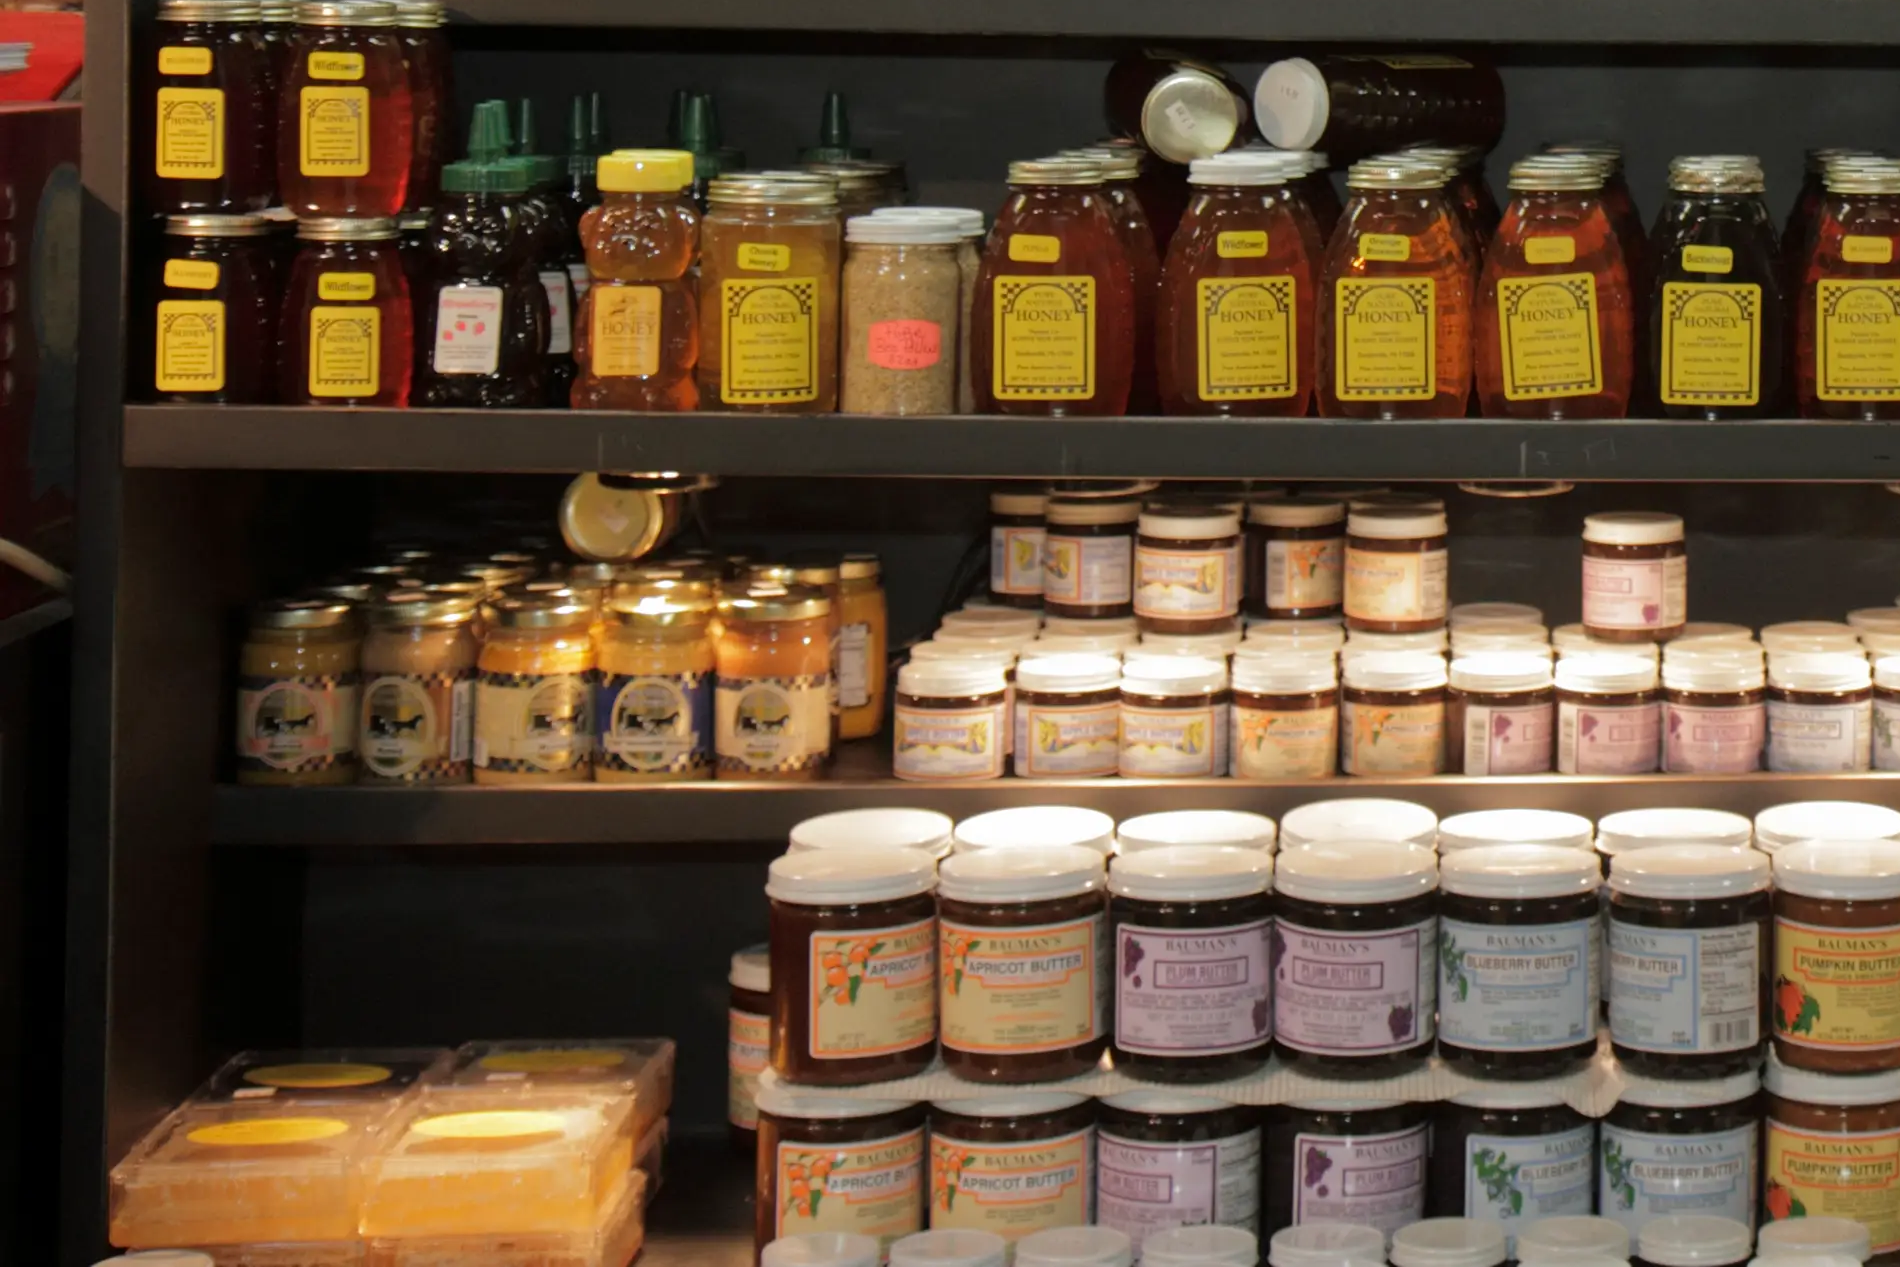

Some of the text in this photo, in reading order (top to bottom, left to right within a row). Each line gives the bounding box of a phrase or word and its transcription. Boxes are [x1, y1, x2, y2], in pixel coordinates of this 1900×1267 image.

[1222, 239, 1264, 250] Wildflower
[742, 313, 798, 325] HONEY
[1016, 309, 1073, 321] HONEY
[1221, 310, 1276, 323] HONEY
[1358, 311, 1414, 323] HONEY
[1521, 307, 1575, 322] HONEY
[1838, 312, 1892, 323] HONEY
[602, 322, 656, 335] HONEY
[1684, 316, 1740, 328] HONEY
[870, 957, 921, 976] APRICOT
[969, 954, 1081, 975] APRICOT BUTTER
[1467, 954, 1575, 970] BLUEBERRY BUTTER
[1638, 960, 1678, 973] BUTTER
[1800, 956, 1856, 972] PUMPKIN
[1166, 963, 1238, 978] PLUM BUTTER
[1301, 965, 1371, 979] PLUM BUTTER
[1522, 1163, 1579, 1182] BLUEBERRY
[1634, 1161, 1740, 1179] BLUEBERRY BUTTER
[1788, 1160, 1840, 1175] PUMPKIN
[830, 1174, 891, 1190] APRICOT
[962, 1169, 1075, 1190] APRICOT BUTTER
[1356, 1170, 1385, 1183] PLUM
